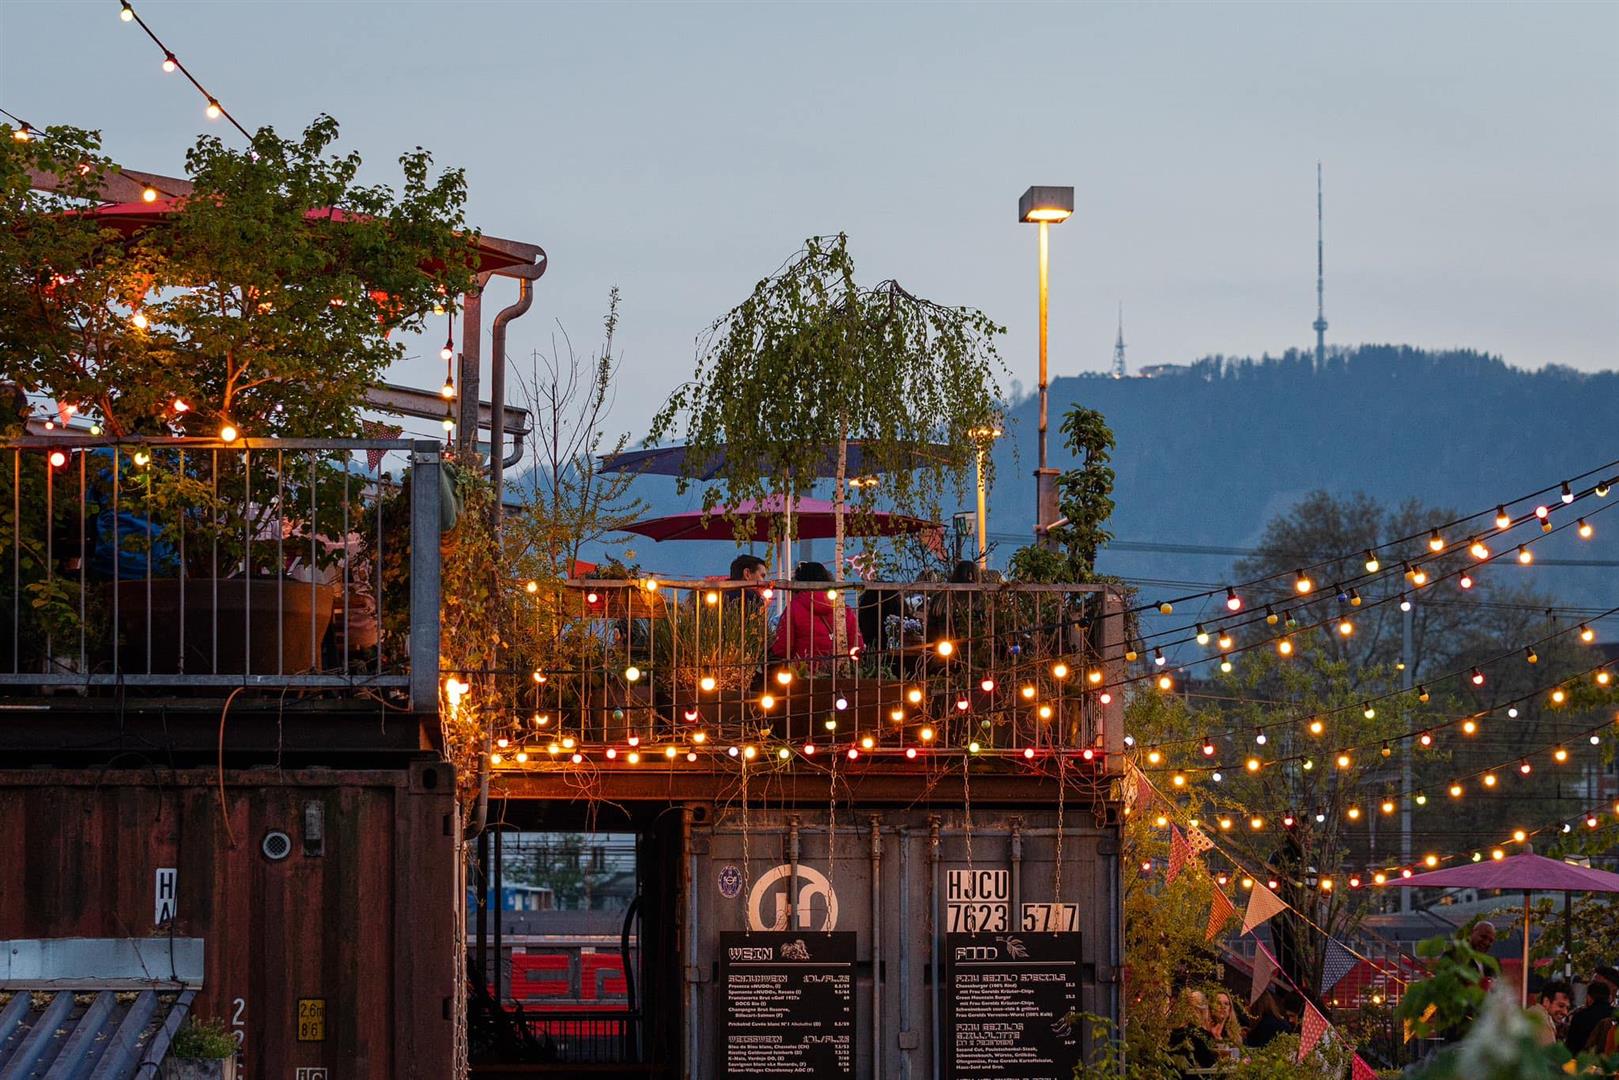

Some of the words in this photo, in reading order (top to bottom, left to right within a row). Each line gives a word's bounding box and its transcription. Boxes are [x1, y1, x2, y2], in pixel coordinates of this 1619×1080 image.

[949, 871, 1007, 899] HJCU
[949, 904, 1007, 932] 7623
[729, 947, 773, 960] WEIN
[955, 946, 998, 960] FOOD
